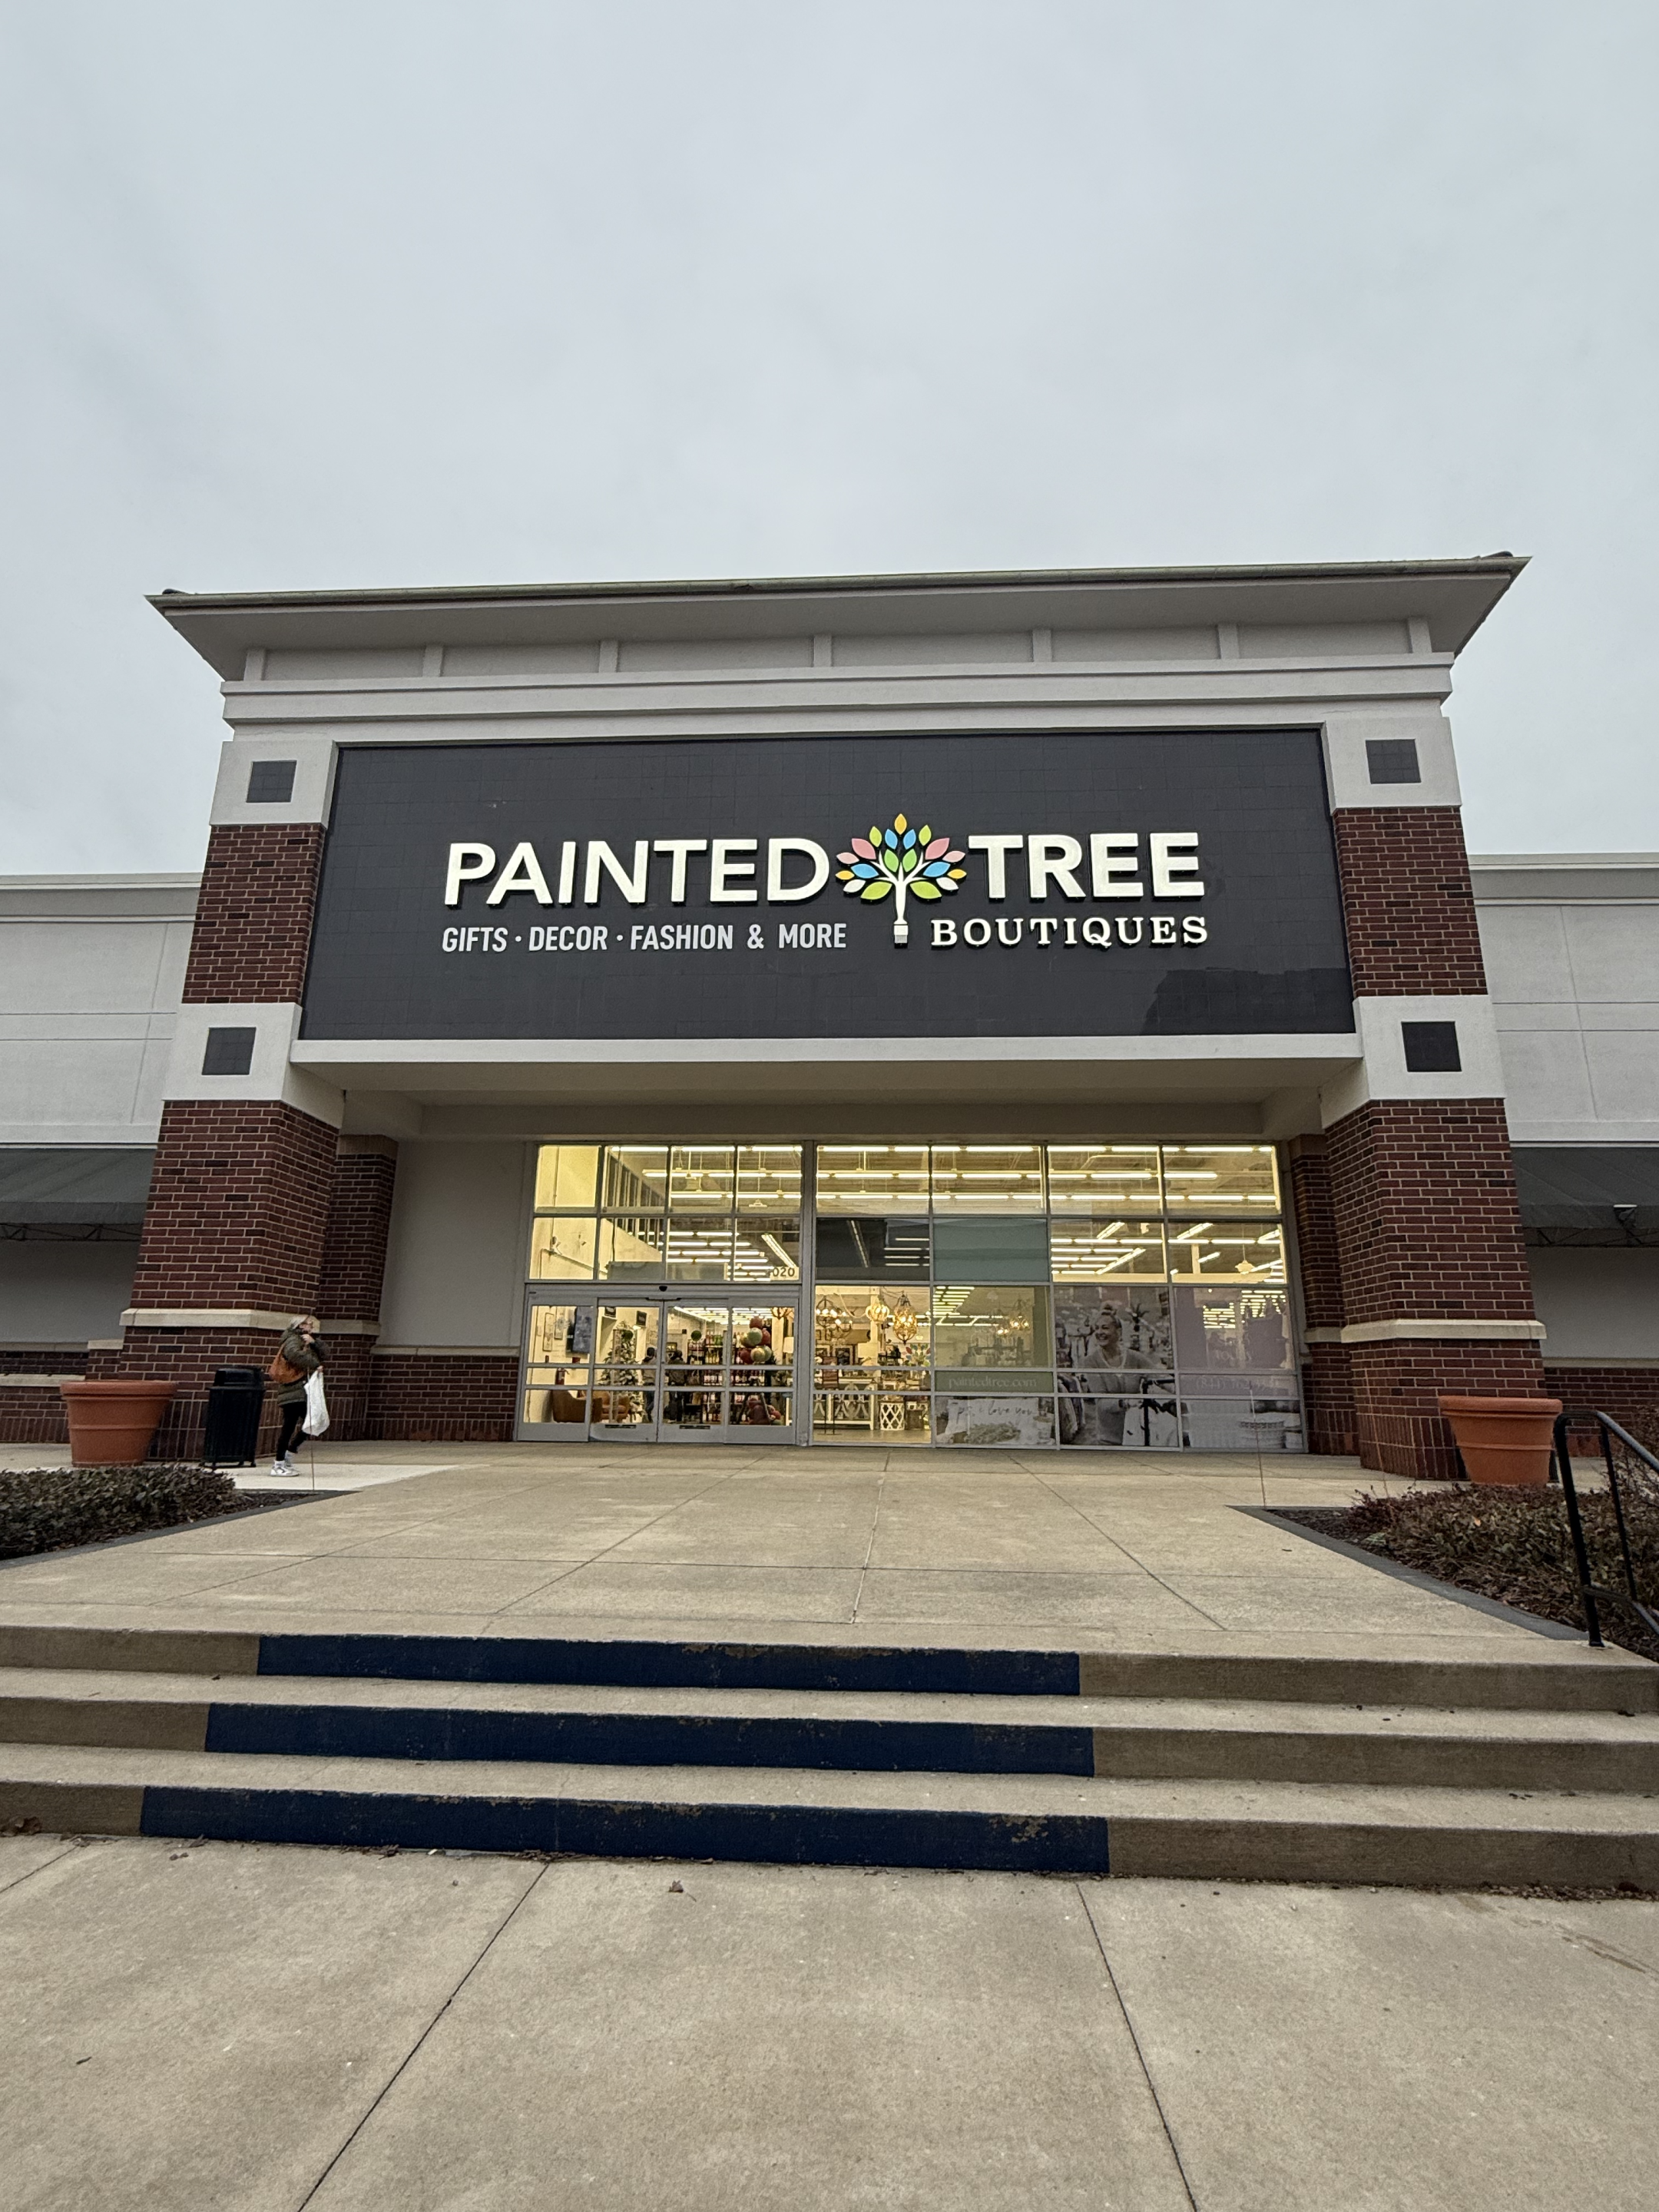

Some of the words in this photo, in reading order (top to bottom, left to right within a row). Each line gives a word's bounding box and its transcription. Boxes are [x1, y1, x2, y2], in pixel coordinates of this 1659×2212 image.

[445, 838, 830, 906] PAINTED
[969, 833, 1204, 899] TREE
[442, 926, 508, 952] GIFTS
[528, 926, 608, 951] DECOR
[630, 924, 733, 950] FASHION
[747, 923, 765, 949] &
[778, 922, 847, 949] MORE
[930, 916, 1208, 949] BOUTIQUES
[949, 1376, 1037, 1389] paintedtree.com
[988, 1400, 1009, 1416] love
[1015, 1406, 1033, 1424] you
